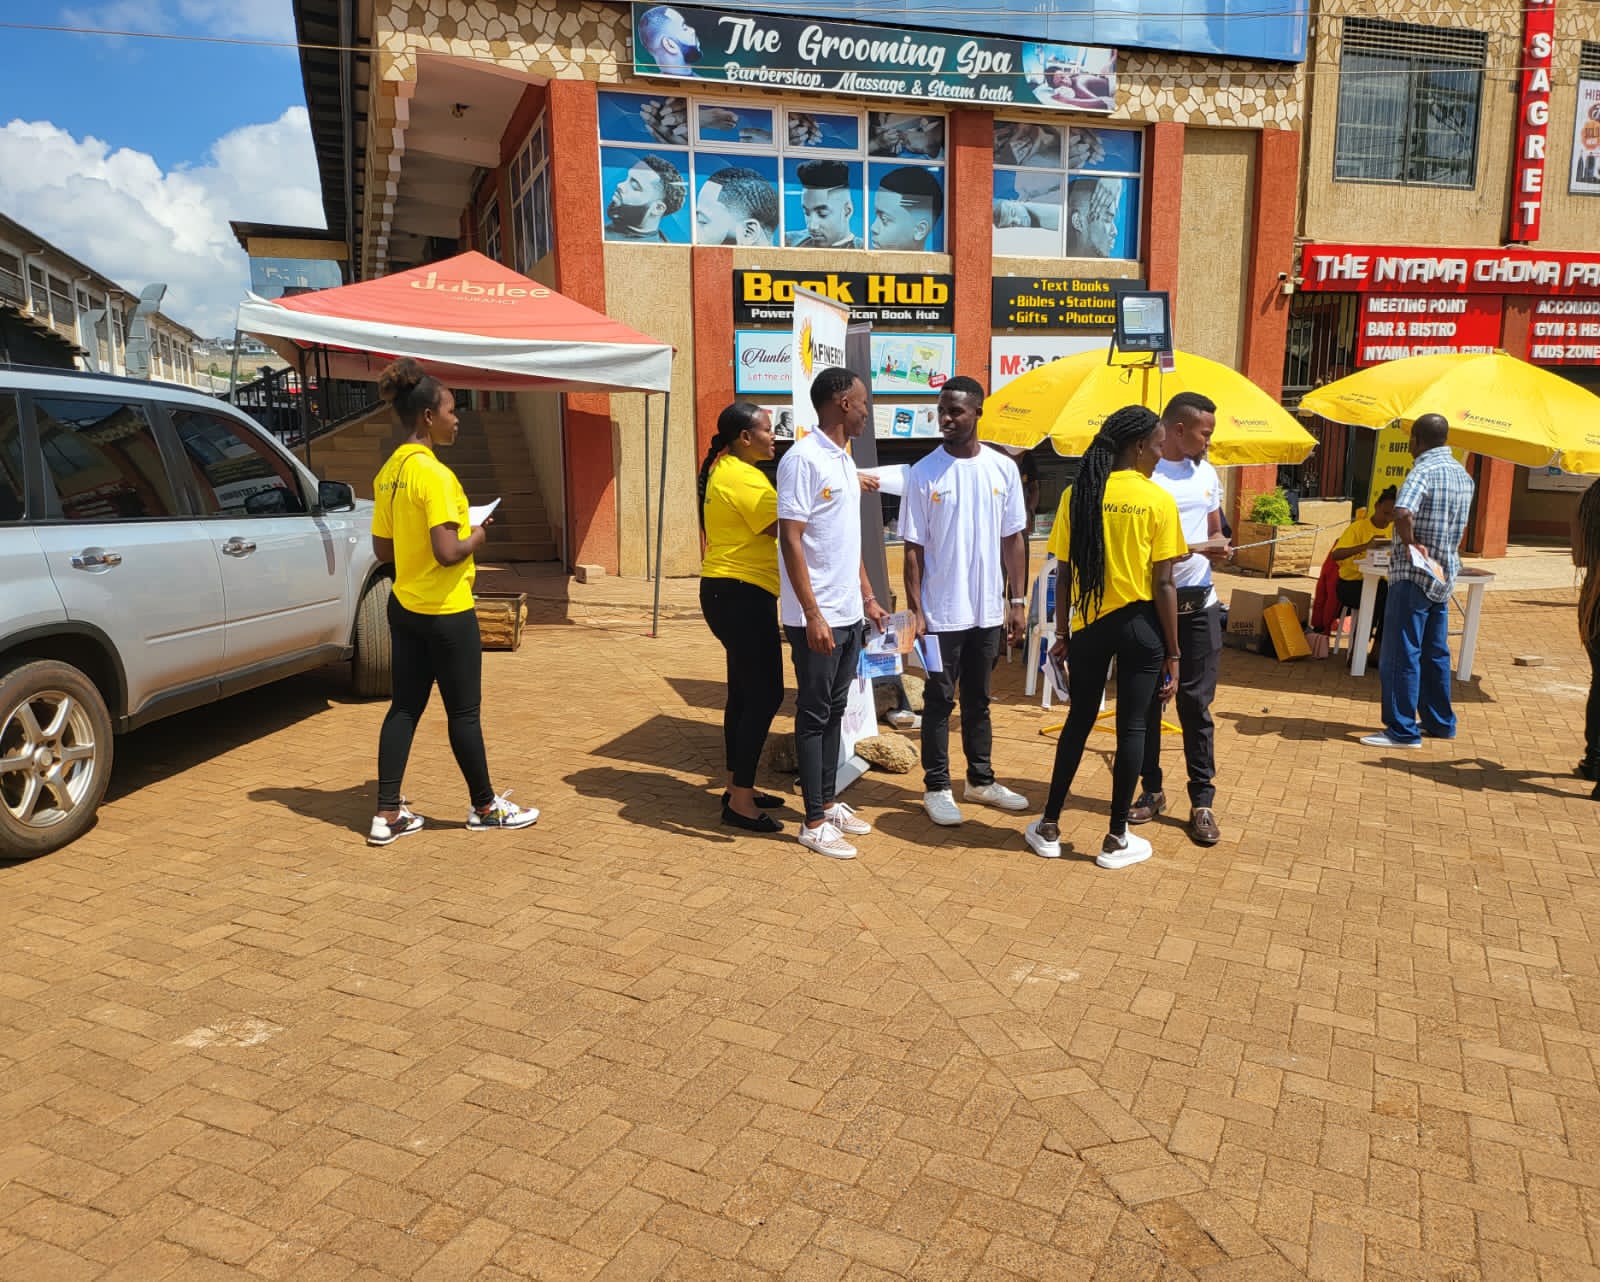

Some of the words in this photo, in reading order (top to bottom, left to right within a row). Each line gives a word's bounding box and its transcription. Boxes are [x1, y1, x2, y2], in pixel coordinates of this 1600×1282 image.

[718, 16, 781, 54] The
[798, 25, 945, 75] Grooming
[957, 41, 1012, 79] Spa
[832, 72, 906, 95] Massage
[911, 80, 922, 95] &
[928, 80, 975, 98] Steam
[979, 86, 1014, 102] bath
[1520, 33, 1551, 225] SAGRET
[1312, 254, 1370, 281] THE
[1374, 256, 1467, 283] NYAMA
[1473, 257, 1560, 286] CHOMA
[410, 271, 551, 298] Jubilee
[743, 272, 854, 303] Book
[867, 275, 948, 304] Hub
[1041, 279, 1068, 292] Text
[1072, 279, 1110, 293] Books
[1016, 295, 1055, 307] Bibles
[1367, 298, 1427, 313] MEETING
[1428, 299, 1468, 313] POINT
[881, 310, 912, 320] Book
[915, 310, 940, 320] Hub
[1016, 311, 1048, 323] Gifts
[1065, 311, 1116, 324] Photoco
[1366, 321, 1394, 337] BAR
[1395, 322, 1406, 337] &
[1408, 322, 1457, 337] BISTRO
[1535, 322, 1564, 337] GYM
[1566, 322, 1577, 337] &
[1364, 345, 1410, 361] NYAMA
[1531, 344, 1565, 358] KIDS
[1565, 344, 1600, 358] ZONE
[1120, 503, 1147, 515] Solar
